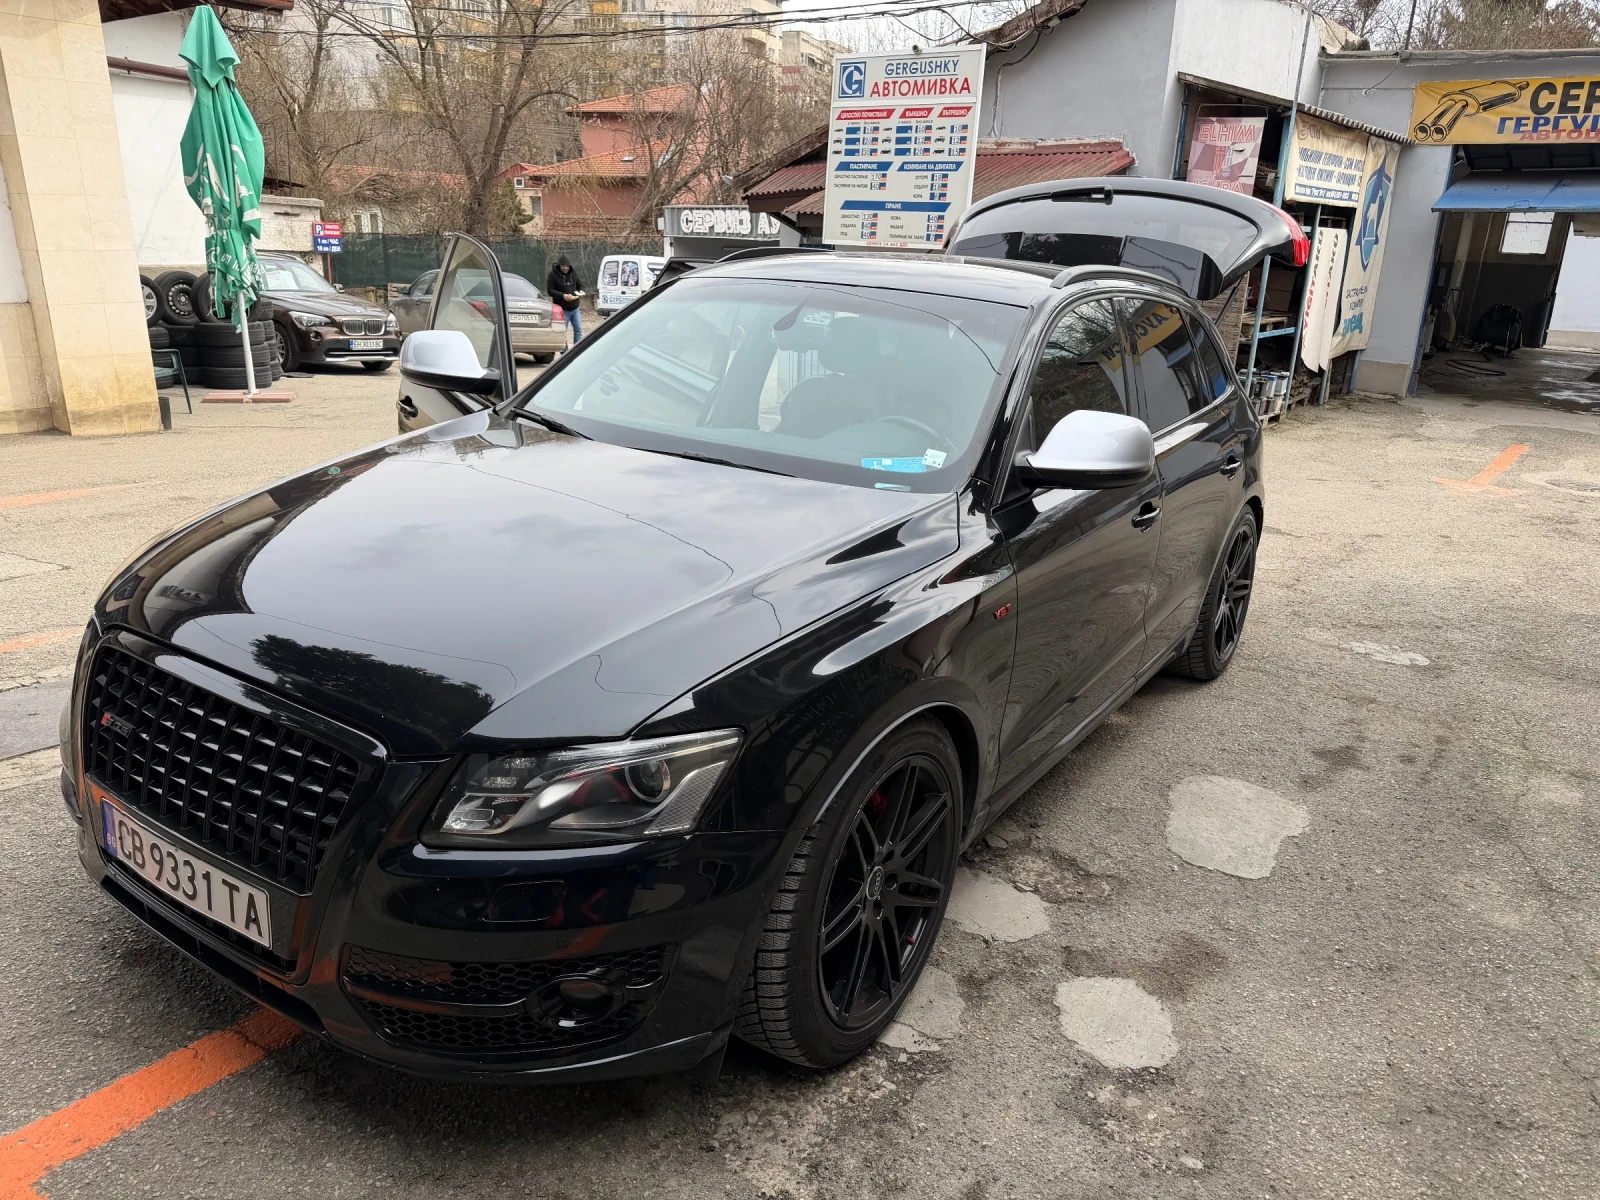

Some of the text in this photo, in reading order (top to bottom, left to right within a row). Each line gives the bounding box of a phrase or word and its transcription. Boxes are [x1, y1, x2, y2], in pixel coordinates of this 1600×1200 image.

[884, 59, 960, 76] GERGUSHKY
[869, 77, 972, 98] АВТОМИВКА
[1200, 124, 1256, 142] ELHIM
[680, 210, 752, 234] СЕРВИЗ
[106, 834, 116, 848] BG
[118, 819, 263, 938] CB 9331 TA
